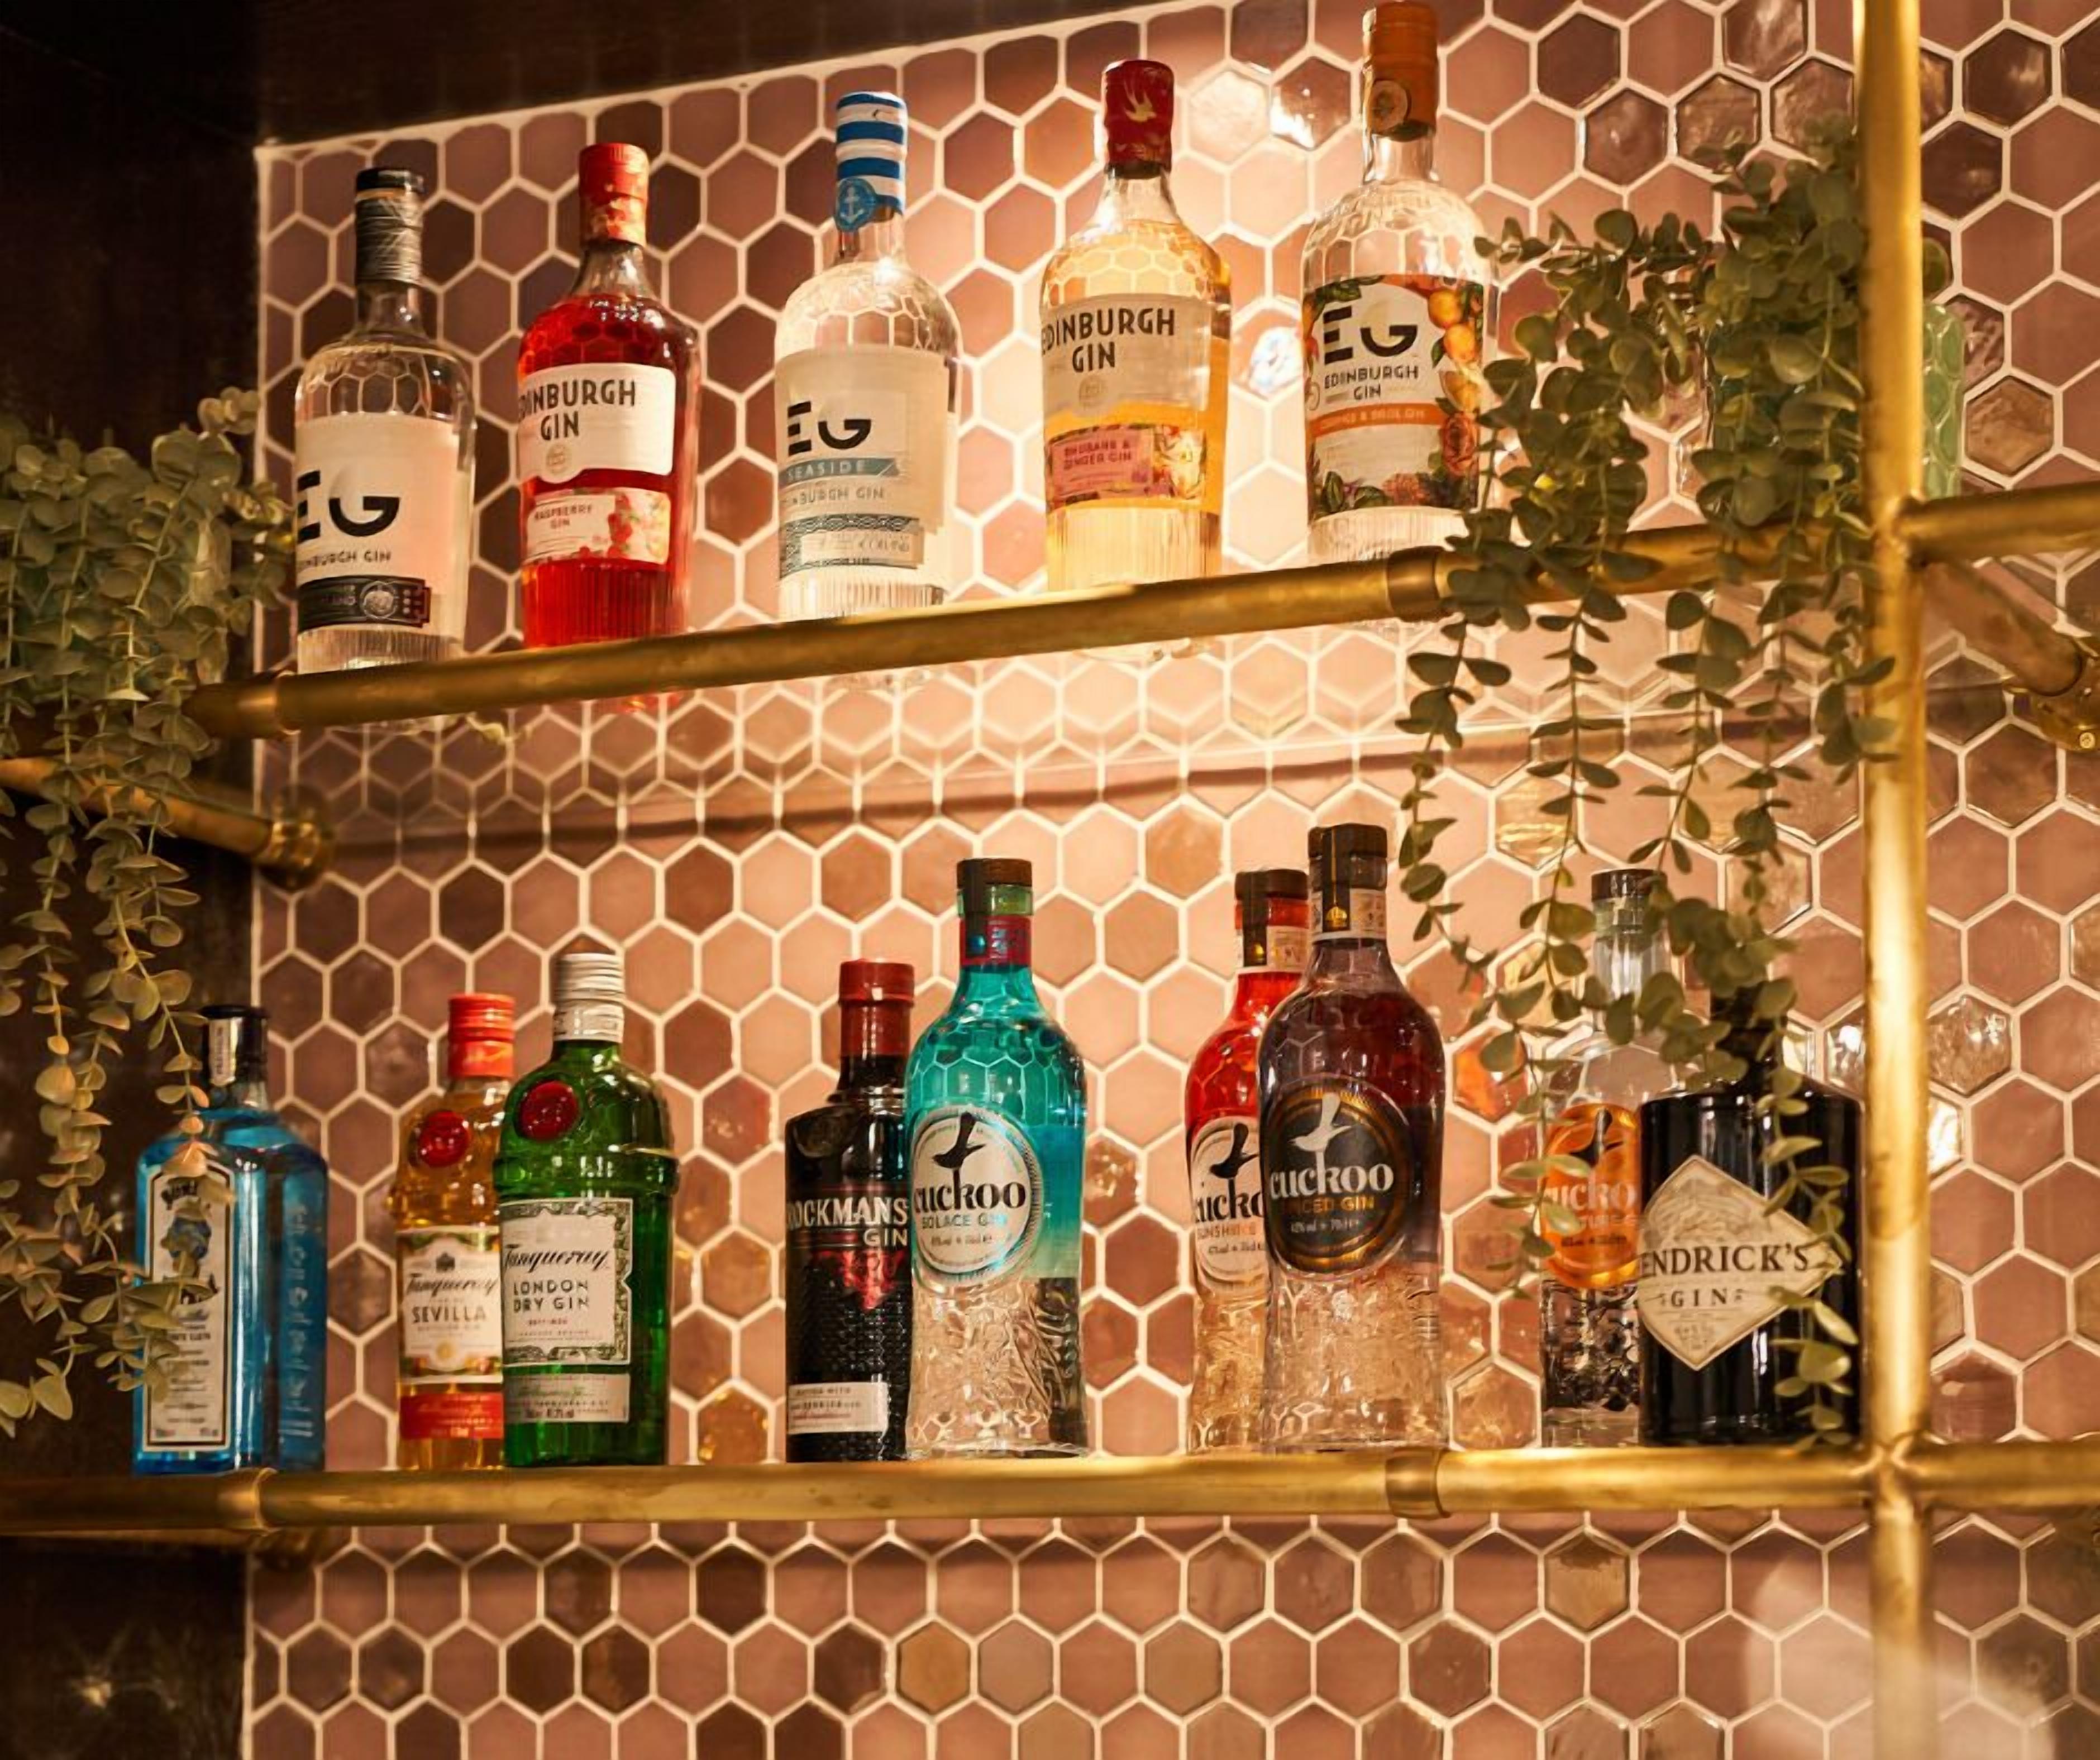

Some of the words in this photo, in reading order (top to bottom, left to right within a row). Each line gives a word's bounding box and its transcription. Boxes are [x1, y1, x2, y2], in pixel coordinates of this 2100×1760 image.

[1072, 341, 1115, 372] GIN
[1324, 365, 1419, 389] EDINBURGH
[1354, 384, 1381, 400] GIN
[541, 411, 579, 441] GIN
[788, 460, 865, 481] SEASIDE
[856, 486, 884, 499] GIN
[1270, 1159, 1394, 1199] cuckoo
[1341, 1194, 1374, 1212] GIN
[863, 1228, 908, 1246] GIN
[503, 1244, 609, 1274] Tanqueray
[1640, 1243, 1808, 1279] ENDRICK'S
[514, 1279, 588, 1296] LONDON
[514, 1298, 544, 1313] DRY
[553, 1297, 589, 1310] GIN
[1671, 1288, 1727, 1307] GIN
[412, 1306, 486, 1324] SEVILLA
